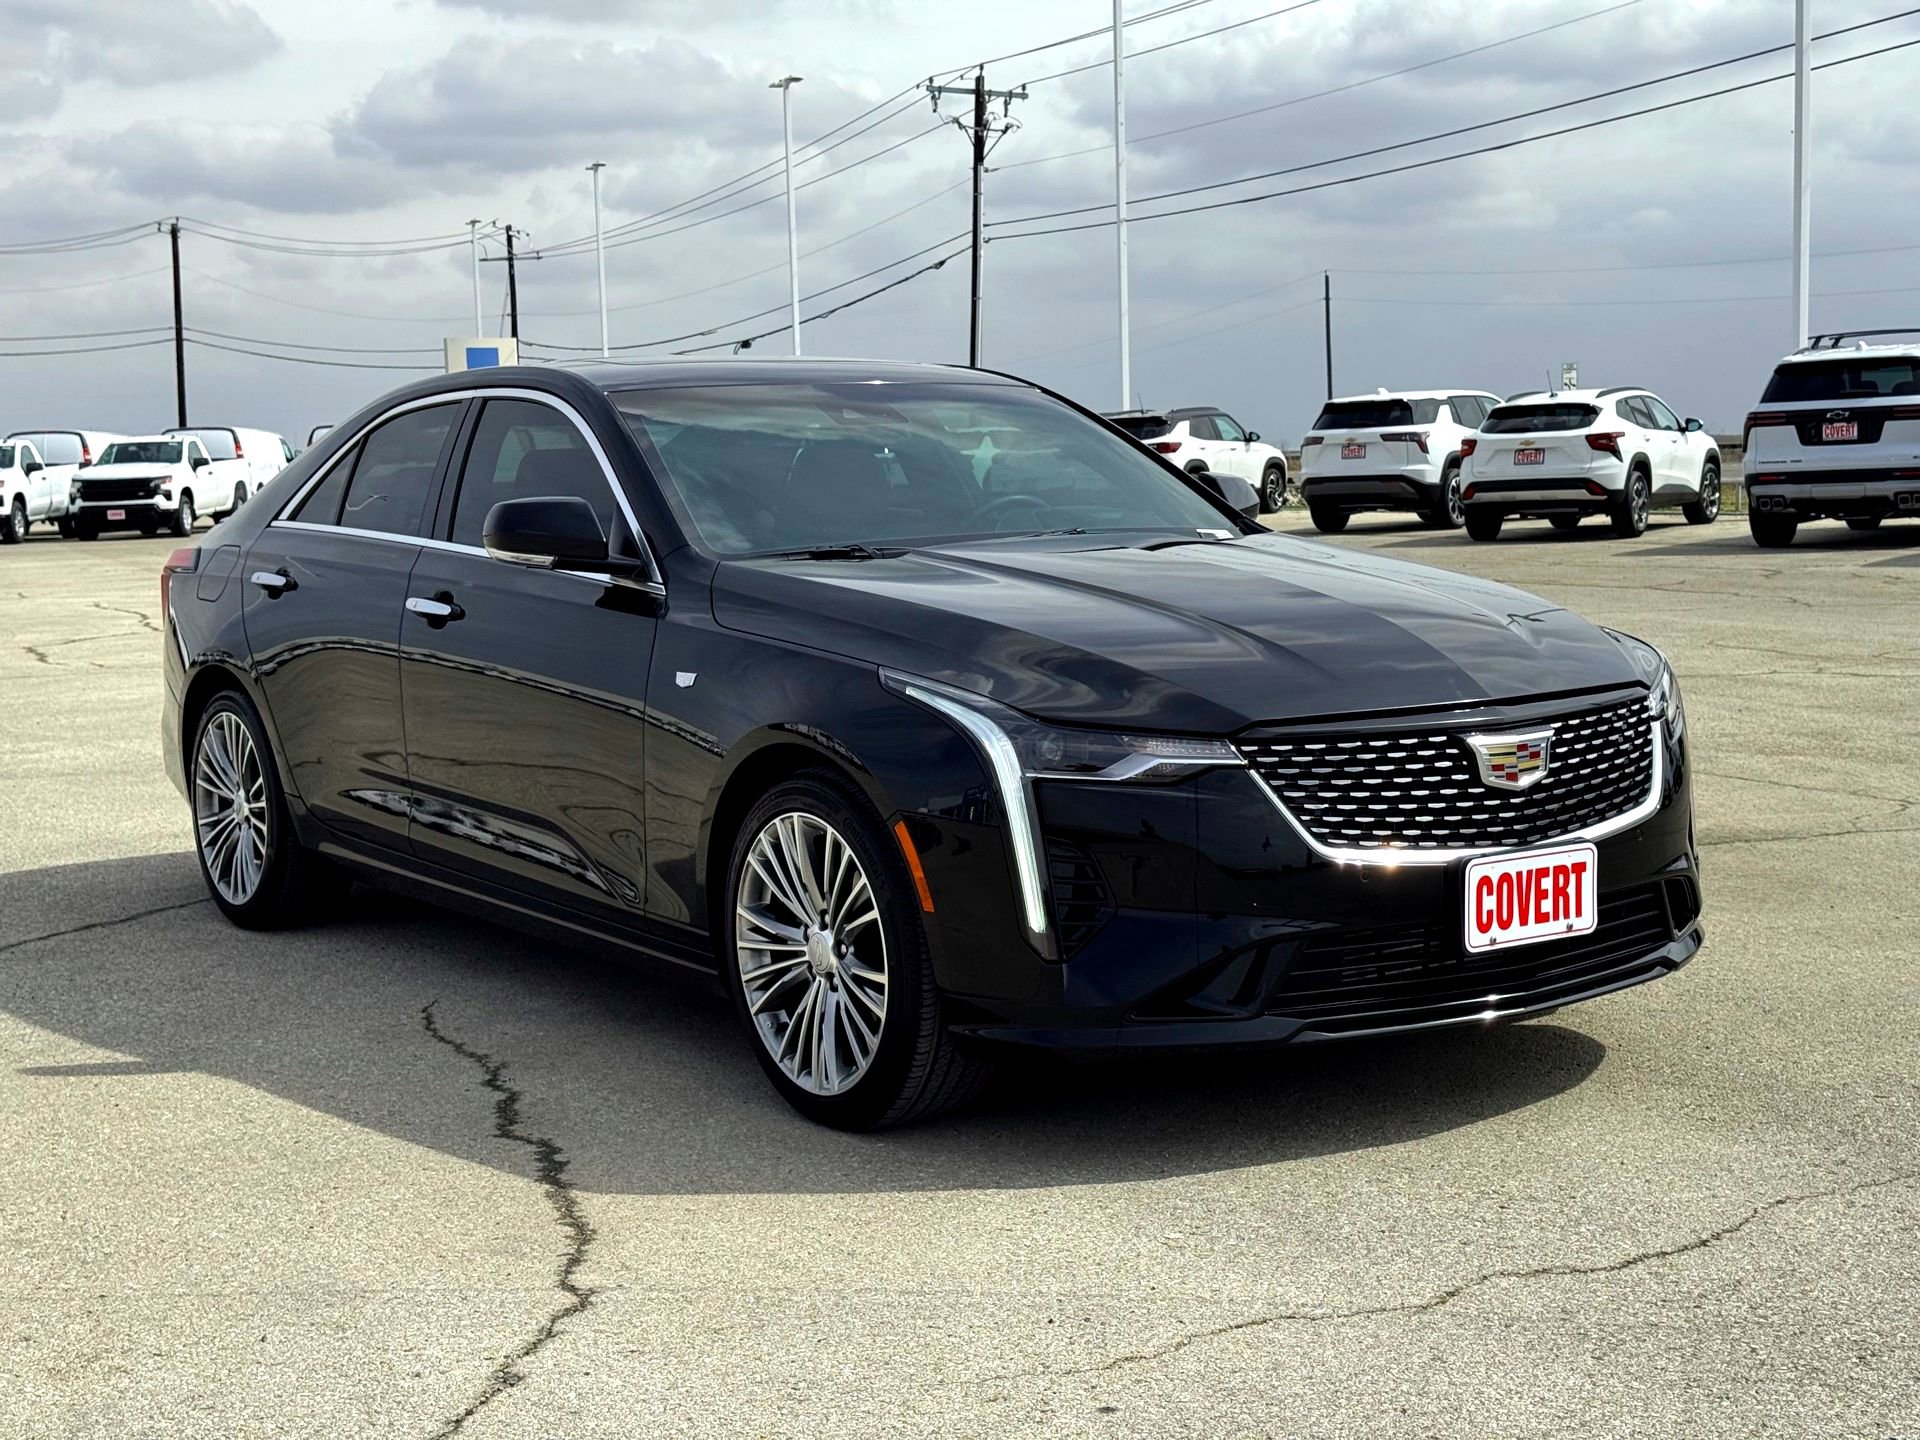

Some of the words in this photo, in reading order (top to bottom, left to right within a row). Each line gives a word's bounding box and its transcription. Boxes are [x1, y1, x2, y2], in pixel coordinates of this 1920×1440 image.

[1825, 423, 1855, 438] COVERT
[1343, 447, 1363, 457] COVERT
[1517, 450, 1542, 462] COVERT
[1476, 861, 1587, 934] COVERT
